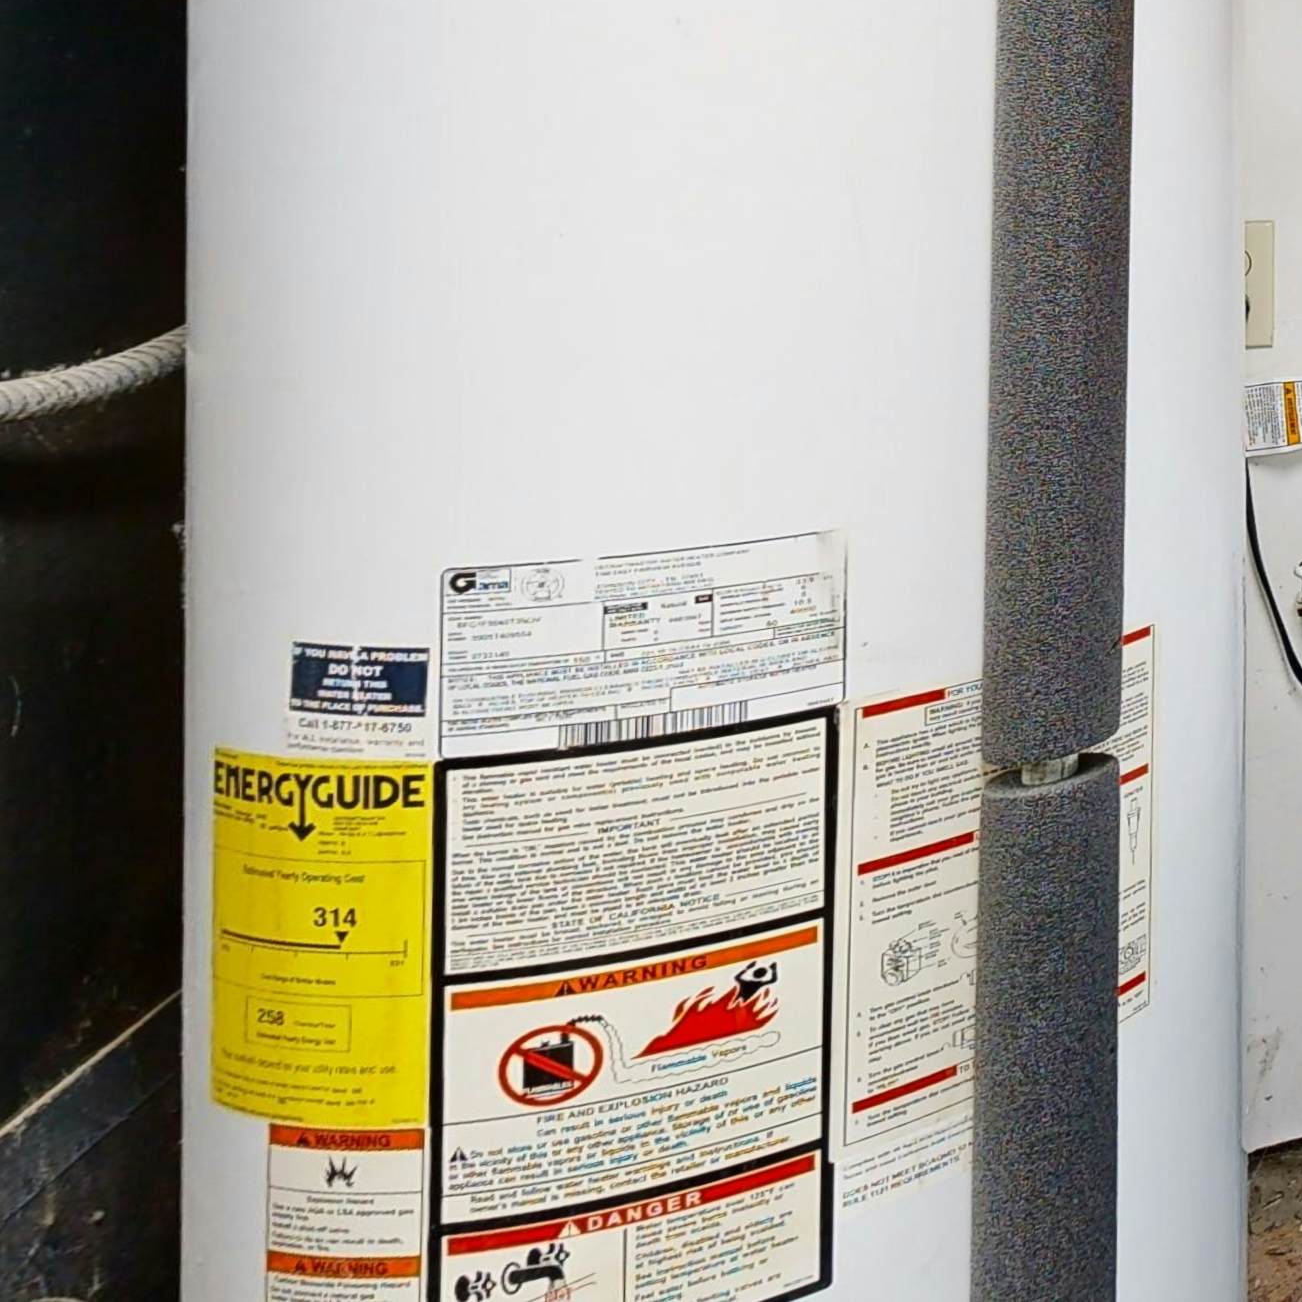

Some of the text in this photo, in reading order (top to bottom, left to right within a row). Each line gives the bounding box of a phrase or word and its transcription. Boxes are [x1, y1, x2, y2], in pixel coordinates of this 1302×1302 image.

[304, 648, 326, 658] YOU
[370, 652, 429, 661] PROBLEM
[328, 663, 384, 676] DO NOT
[298, 718, 318, 728] Call
[214, 759, 425, 810] ENERGYGUIDE
[598, 818, 660, 834] IMPORTANT
[302, 871, 342, 885] Operating
[680, 893, 720, 907] NOTICE
[313, 907, 357, 928] 314
[579, 956, 707, 991] WARNING
[257, 1007, 285, 1026] 258
[712, 1045, 746, 1059] Vapors
[537, 1113, 564, 1123] FIRE
[568, 1107, 594, 1119] AND
[676, 1077, 728, 1097] HAZARD
[651, 1103, 680, 1114] injury
[315, 1134, 391, 1148] WARNING
[587, 1192, 703, 1231] DANGER
